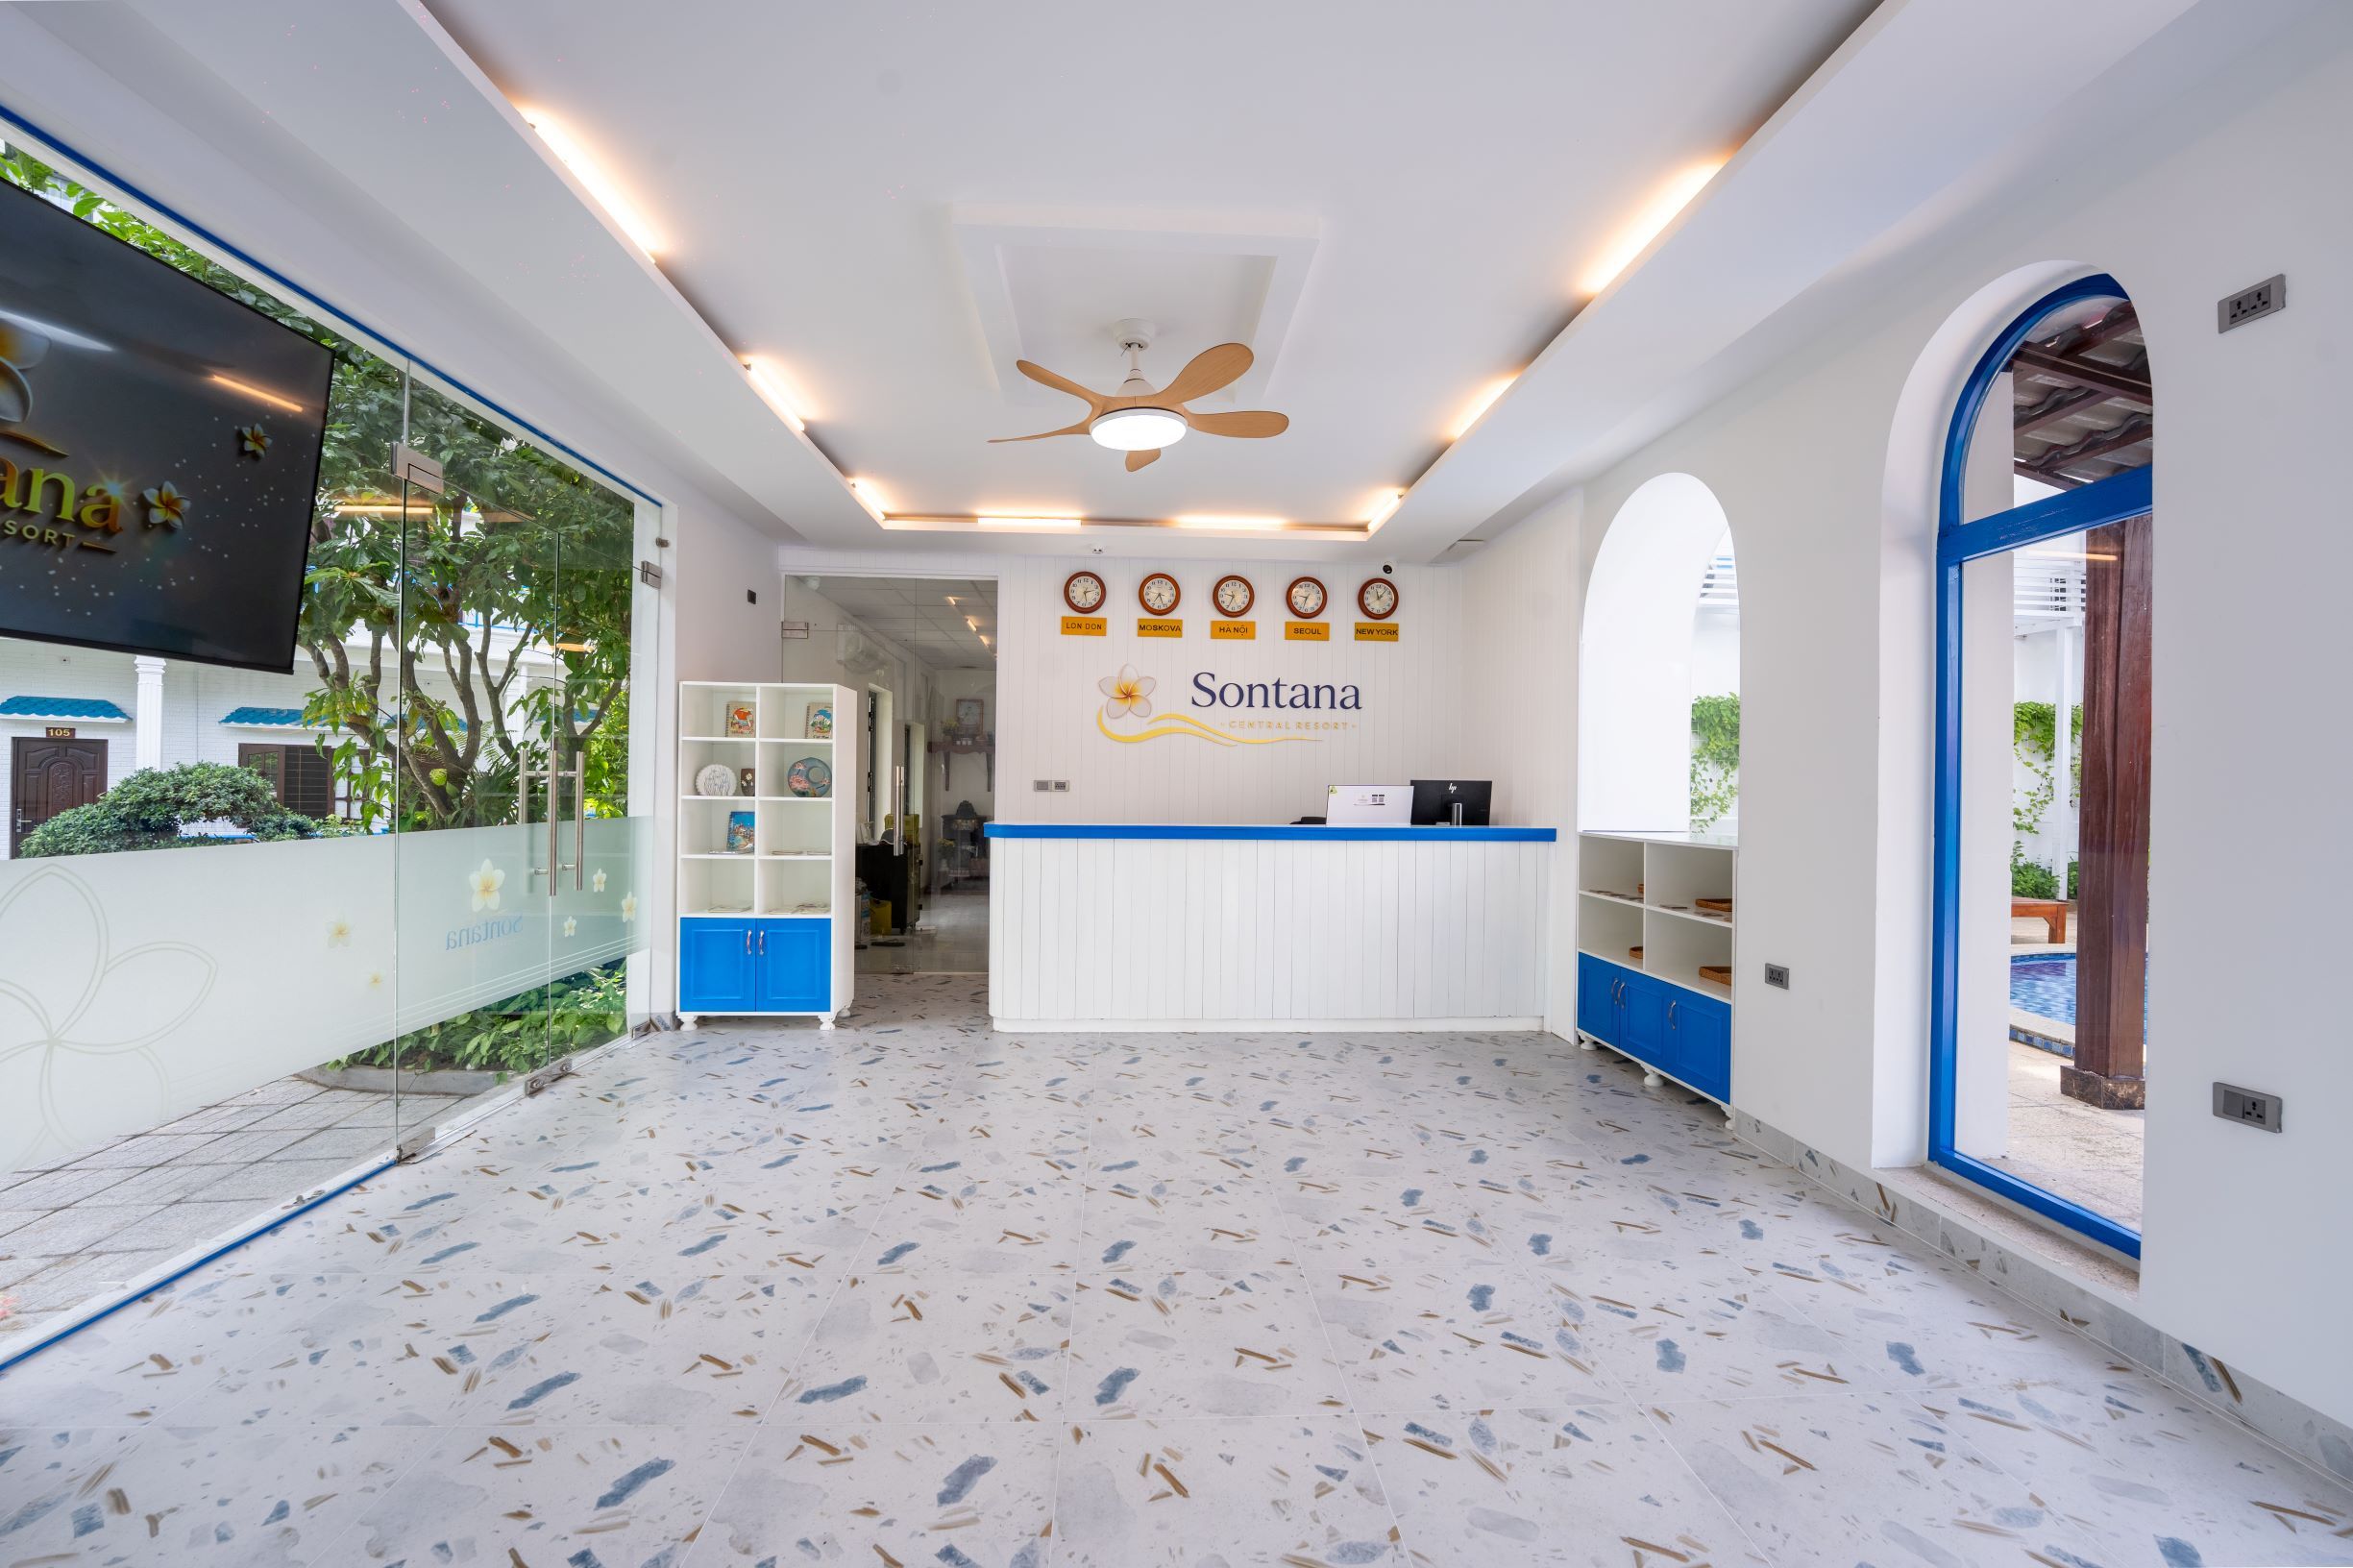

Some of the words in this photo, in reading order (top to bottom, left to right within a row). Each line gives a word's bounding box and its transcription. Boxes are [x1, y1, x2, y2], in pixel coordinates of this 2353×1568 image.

[1191, 672, 1362, 710] Sontana
[1228, 721, 1291, 730] CENTRAL
[1295, 722, 1349, 730] RESORT
[48, 728, 71, 737] 105
